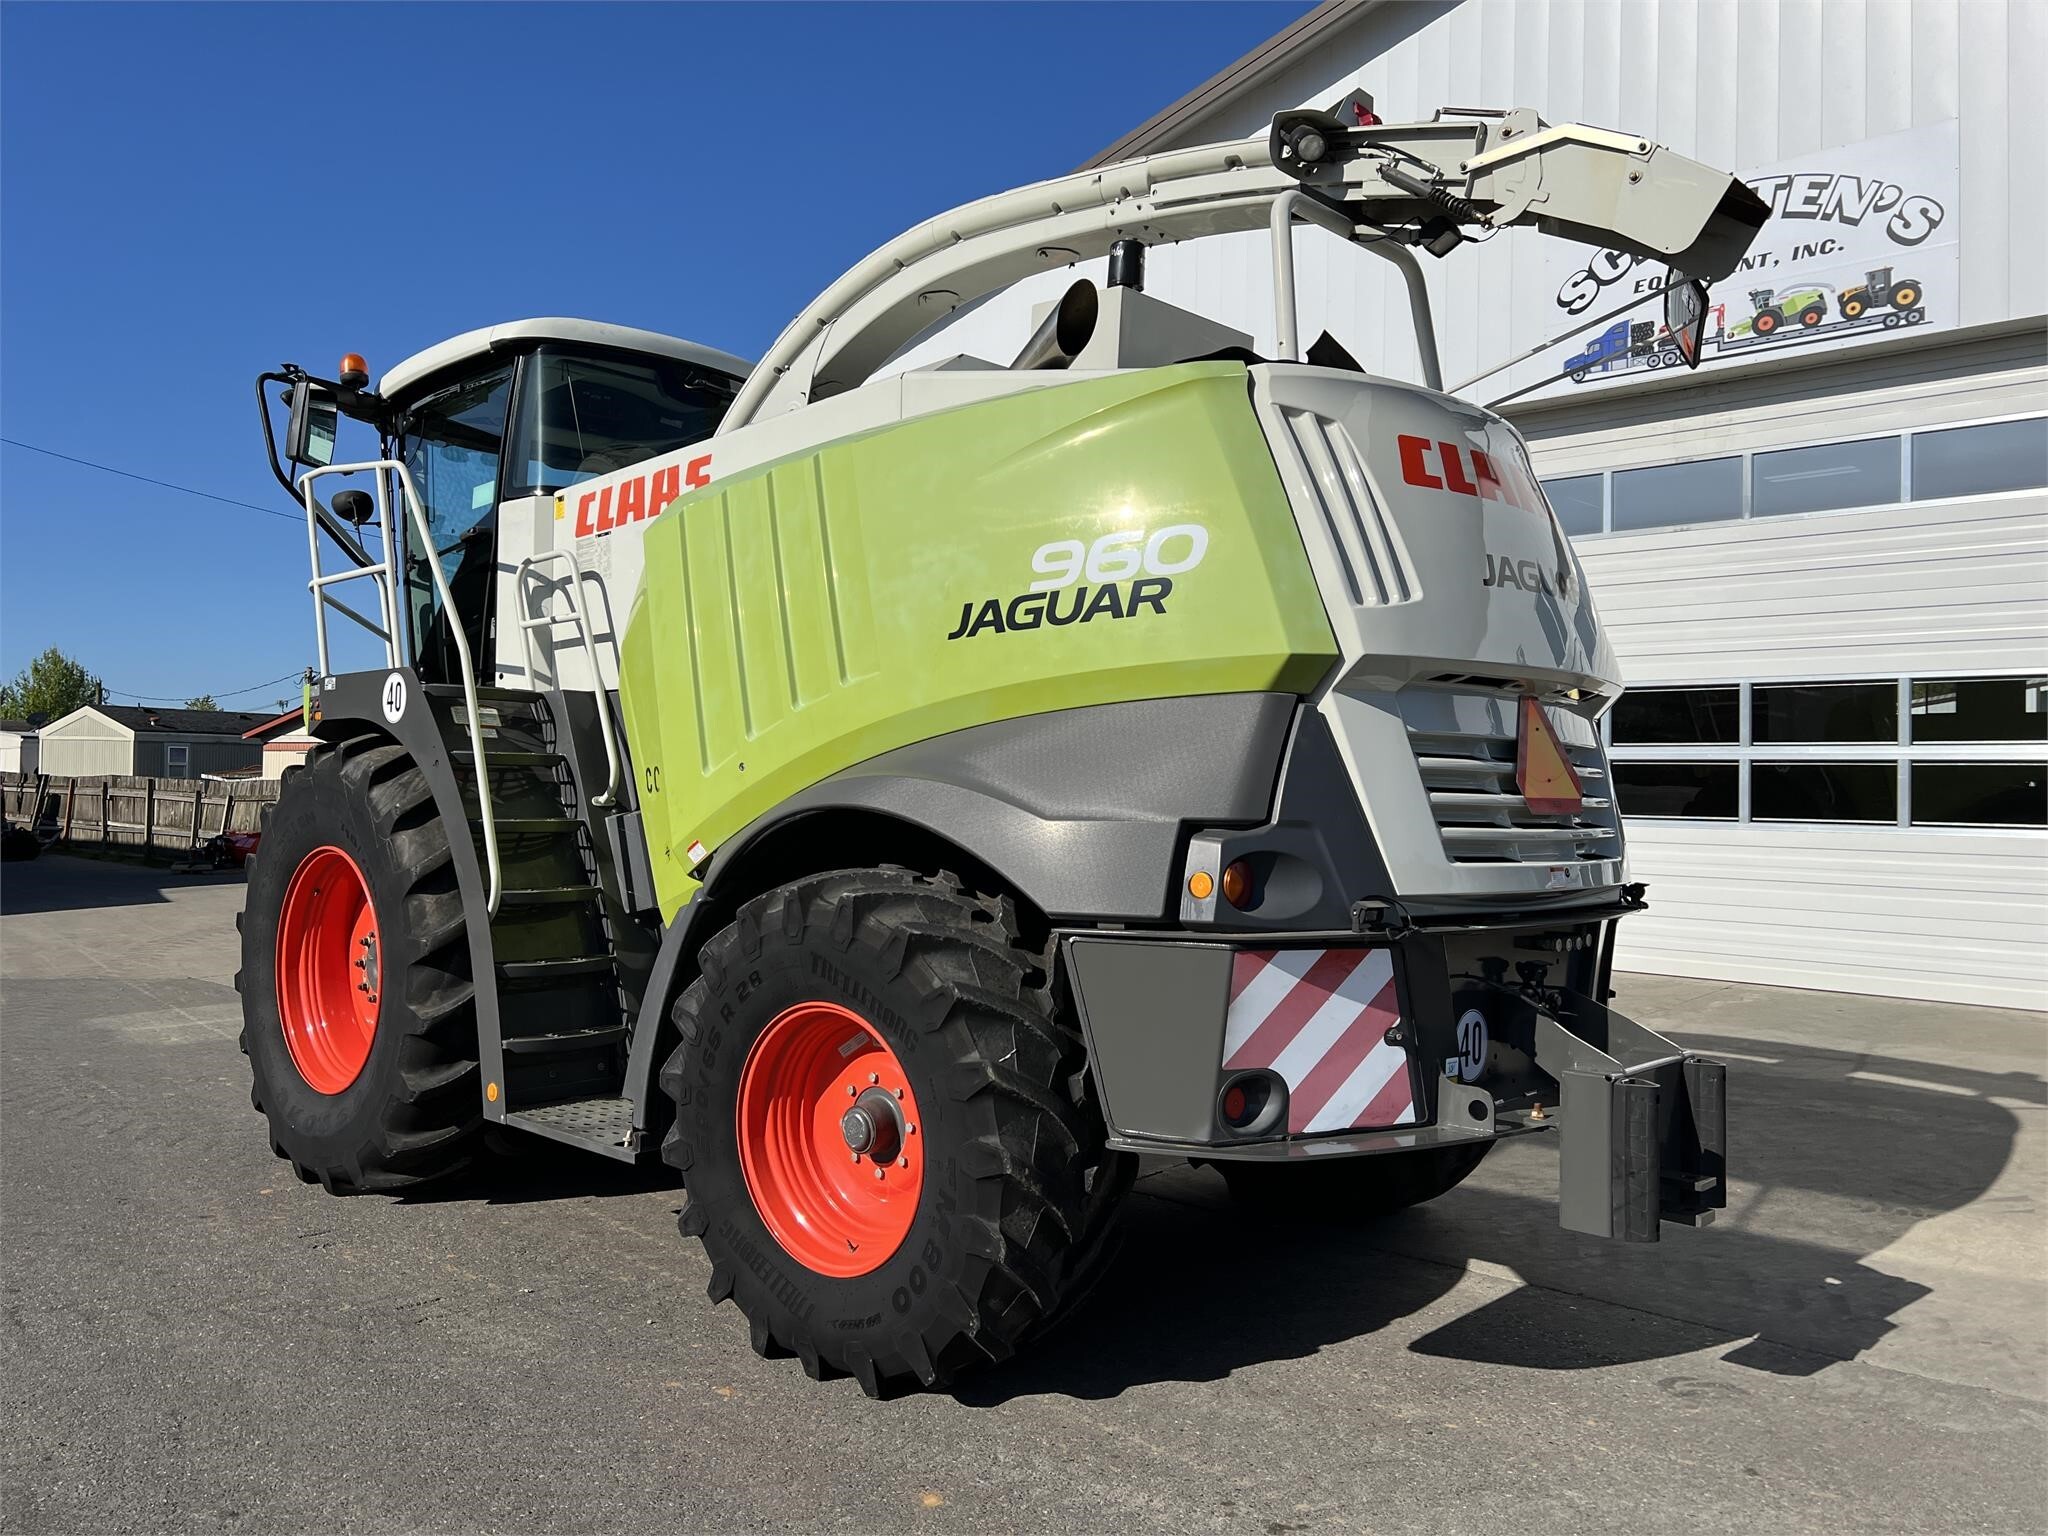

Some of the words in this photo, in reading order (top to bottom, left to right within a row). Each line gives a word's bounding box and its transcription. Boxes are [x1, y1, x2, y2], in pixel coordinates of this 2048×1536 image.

[1792, 238, 1845, 261] INC.
[575, 454, 713, 538] CLAAS
[1397, 434, 1551, 519] CLA
[1029, 524, 1209, 592] 960
[947, 577, 1173, 640] JAGUAR
[387, 681, 402, 713] 40
[720, 1002, 736, 1025] R
[735, 970, 763, 1003] 28
[1459, 1021, 1482, 1067] 40
